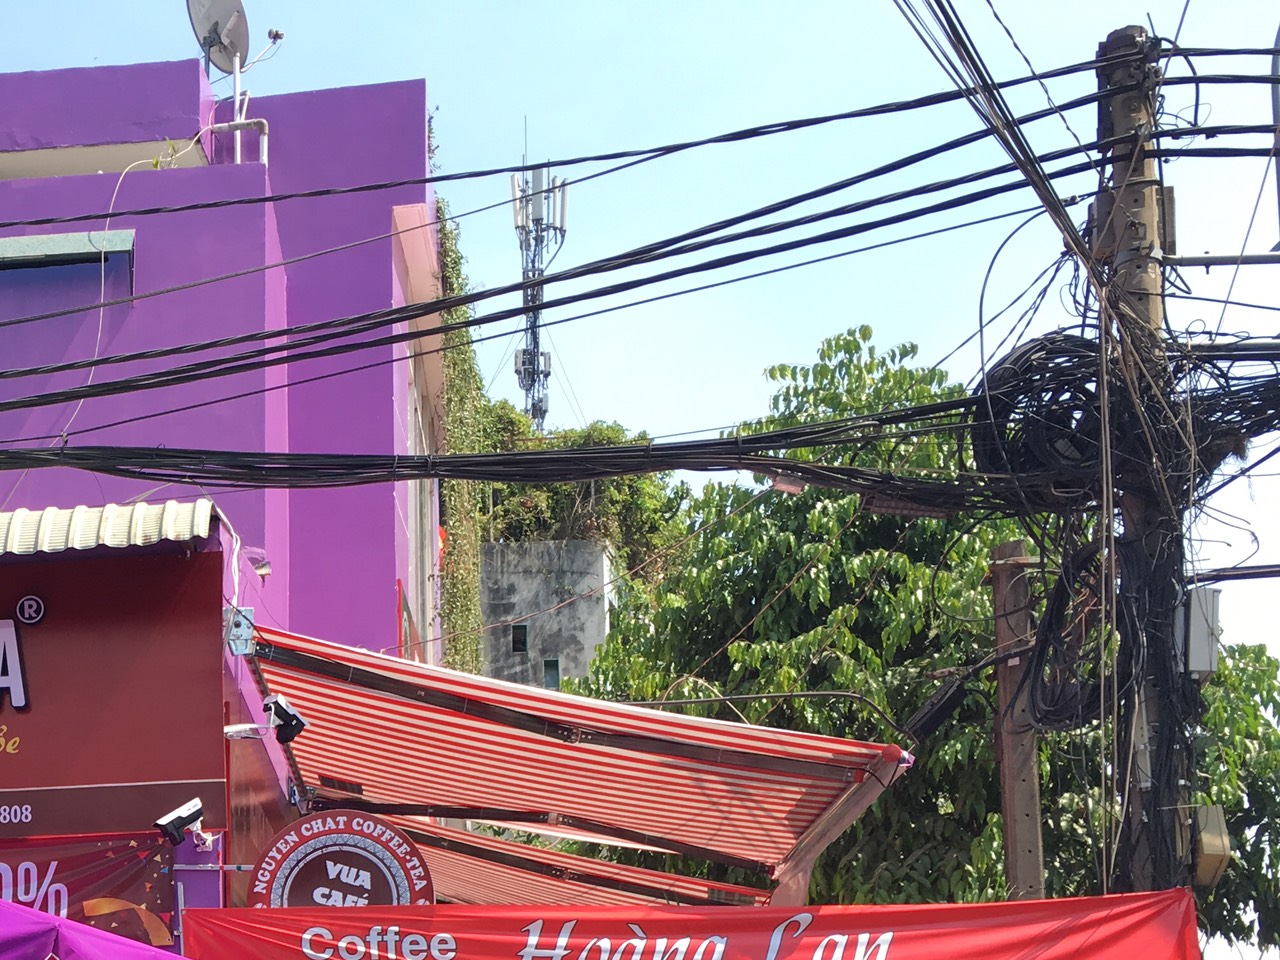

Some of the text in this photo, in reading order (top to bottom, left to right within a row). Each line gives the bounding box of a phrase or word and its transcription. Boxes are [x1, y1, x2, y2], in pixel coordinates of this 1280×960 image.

[253, 831, 300, 894] NGUYEN
[301, 816, 348, 837] CHAT
[324, 860, 371, 890] VUA
